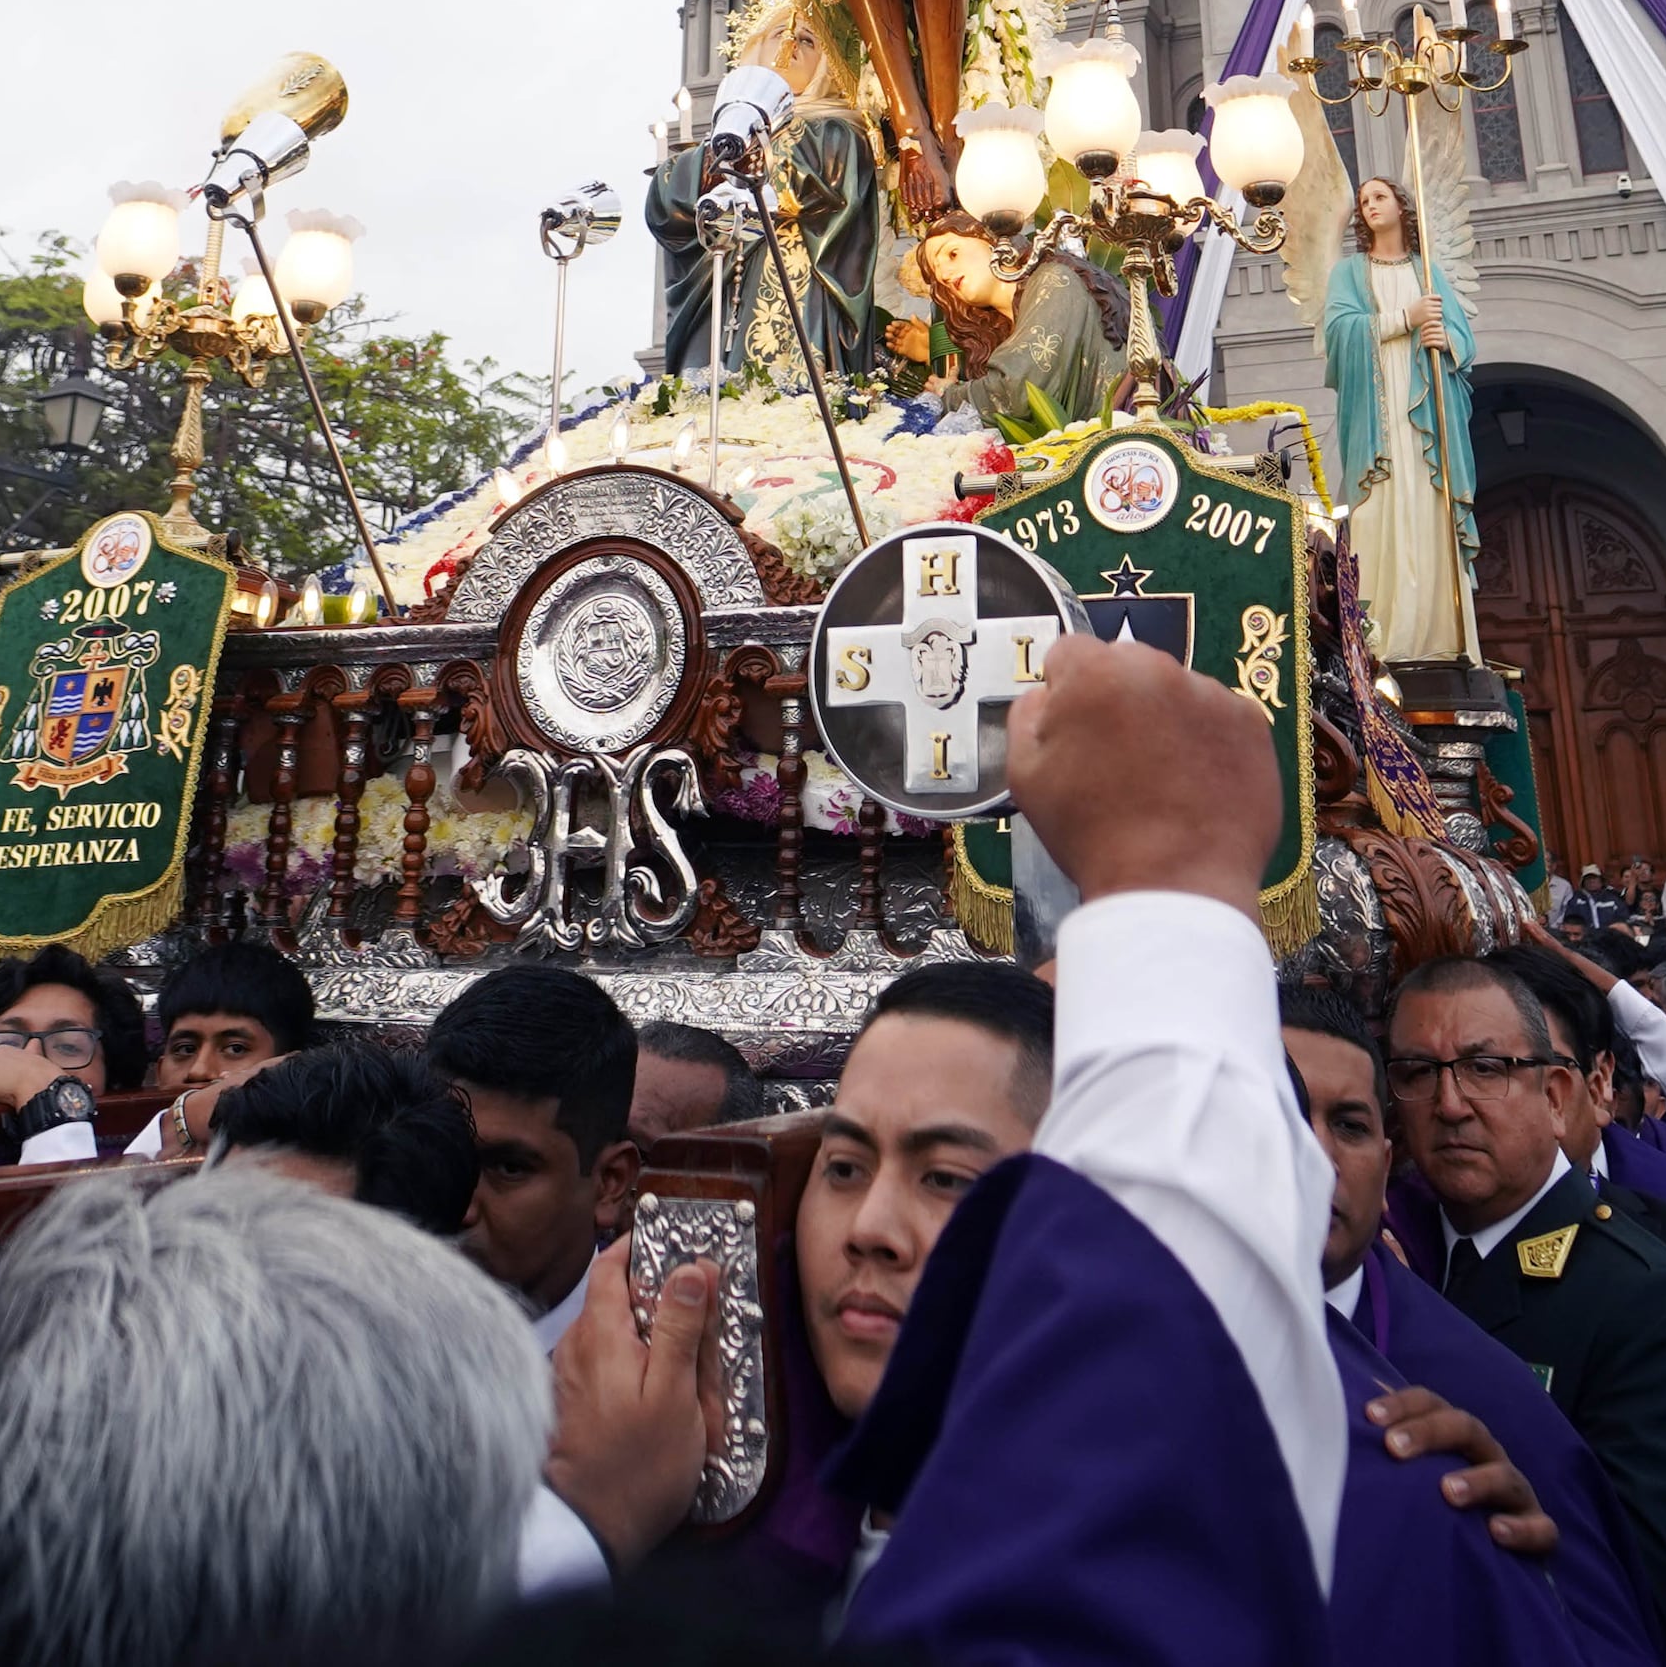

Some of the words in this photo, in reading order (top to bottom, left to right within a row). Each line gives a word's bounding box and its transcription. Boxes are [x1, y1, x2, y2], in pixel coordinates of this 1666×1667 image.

[1184, 493, 1277, 554] 2007
[919, 550, 961, 597] H
[59, 580, 156, 624] 2007
[835, 644, 873, 691] S
[0, 807, 38, 837] FE,
[45, 802, 162, 831] SERVICIO
